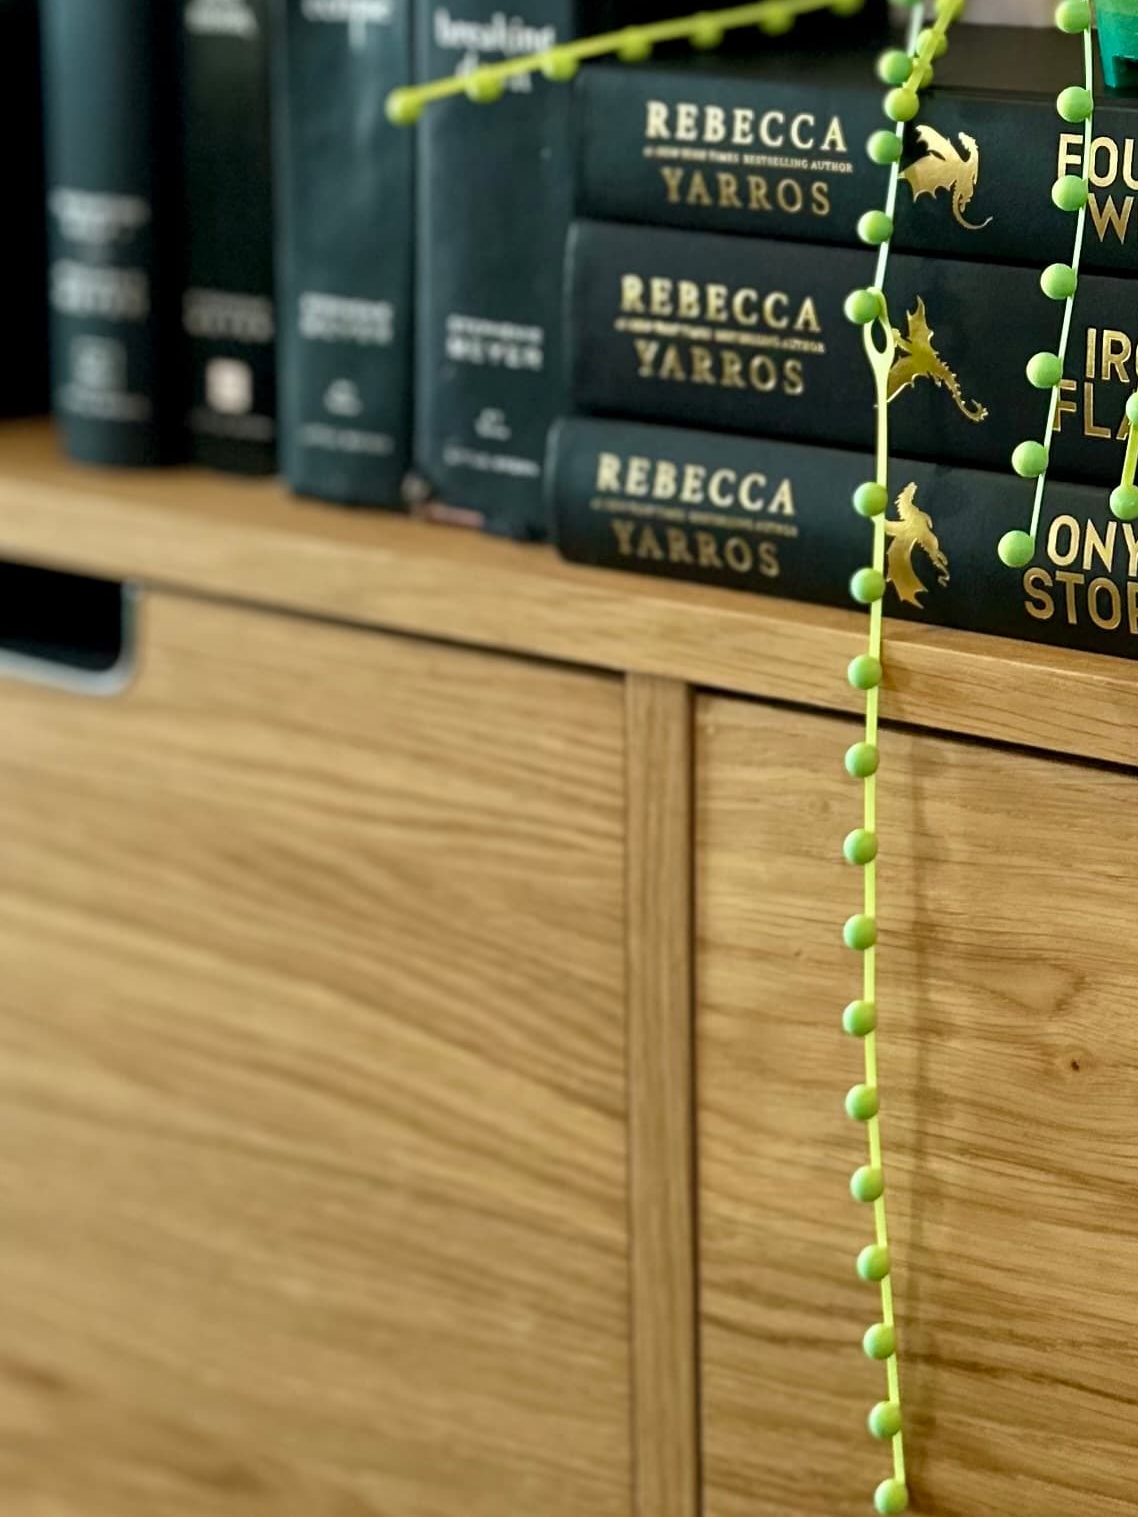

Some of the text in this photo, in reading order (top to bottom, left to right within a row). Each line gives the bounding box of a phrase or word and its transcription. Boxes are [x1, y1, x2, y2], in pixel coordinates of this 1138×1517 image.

[646, 100, 847, 152] REBECCA
[660, 166, 830, 216] YARROS
[810, 161, 854, 173] AUTHOR
[621, 273, 821, 333] REBECCA
[634, 338, 803, 395] YARROS
[596, 451, 795, 515] REBECCA
[611, 518, 779, 577] YARROS
